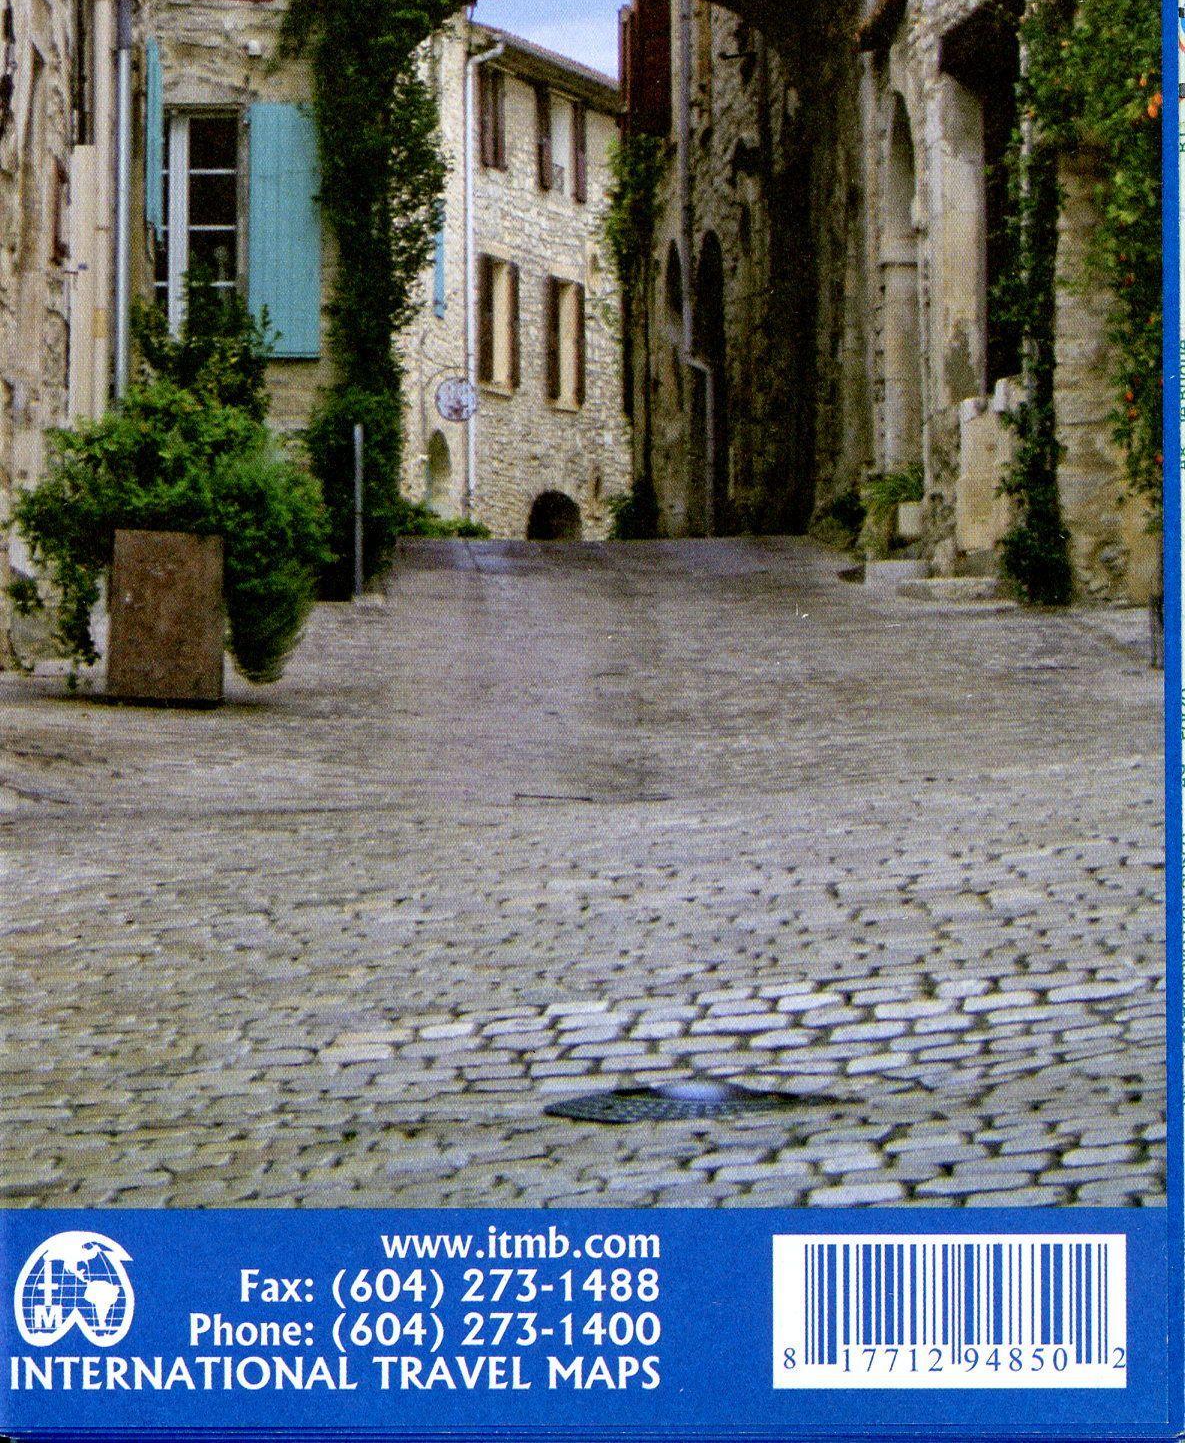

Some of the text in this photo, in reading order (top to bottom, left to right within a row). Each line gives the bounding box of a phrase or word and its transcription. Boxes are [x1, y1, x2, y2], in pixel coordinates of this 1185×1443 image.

[380, 1225, 662, 1260] www.itmb.com
[240, 1267, 661, 1310] Fax: (604) 273-1488
[188, 1311, 662, 1352] Phone: (604) 273-1400
[9, 1354, 662, 1391] INTERNATIONAL TRAVEL MAPS
[782, 1347, 1126, 1373] 8 17712 94850 2
